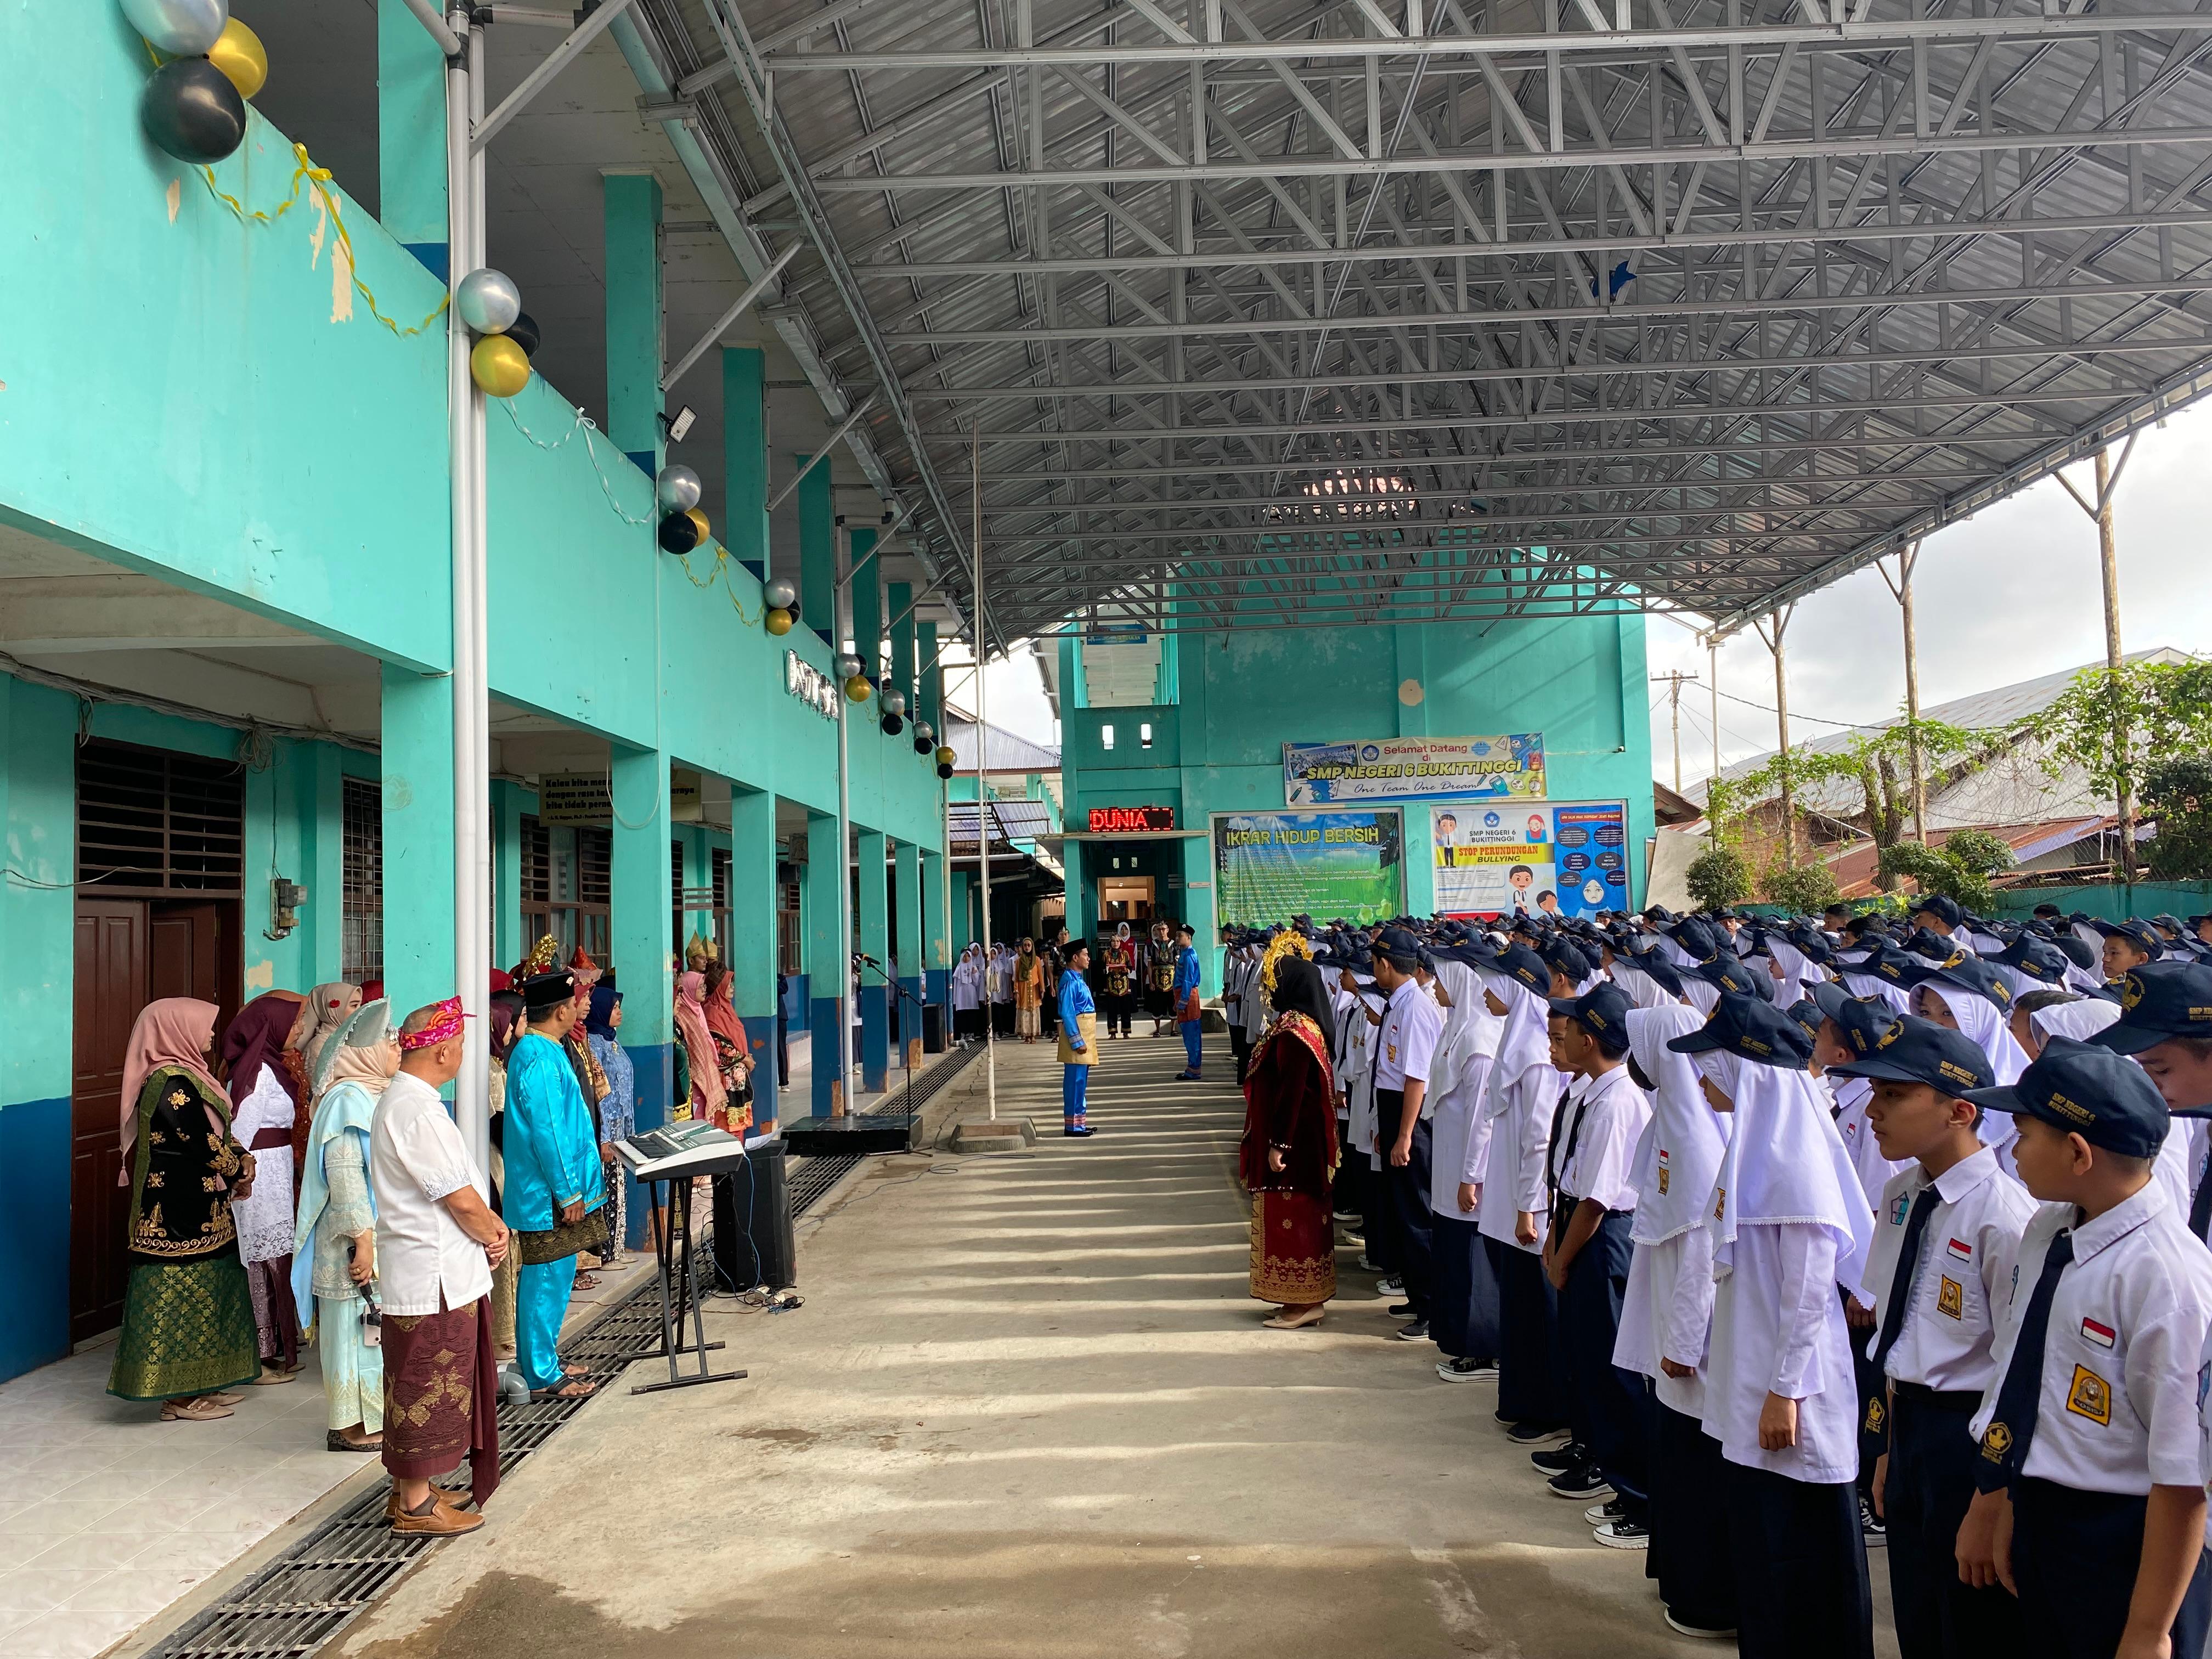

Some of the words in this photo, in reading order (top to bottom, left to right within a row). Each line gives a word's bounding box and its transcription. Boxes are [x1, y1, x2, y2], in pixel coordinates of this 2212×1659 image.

[1384, 745, 1427, 754] Selamat
[1430, 744, 1468, 754] Datang
[1422, 754, 1431, 762] di
[1307, 766, 1341, 780] SMP
[1344, 764, 1402, 778] NEGERI
[1404, 763, 1414, 776] 6
[1417, 759, 1522, 776] BUKITTINGGI
[545, 779, 570, 787] Kalau
[571, 778, 588, 787] kita
[1354, 784, 1376, 794] One
[1381, 782, 1409, 792] Team
[1414, 782, 1435, 791] One
[1441, 781, 1478, 790] Dream
[546, 790, 575, 799] dengan
[672, 788, 695, 796] arnya
[546, 801, 562, 809] kita
[565, 800, 586, 809] tidak
[588, 801, 612, 809] perna
[1092, 811, 1148, 827] DUNIA
[1226, 830, 1271, 846] IKRAR
[1274, 828, 1321, 845] HIDUP
[1324, 827, 1379, 843] BERSIH
[1459, 848, 1477, 856] STOP
[1480, 845, 1538, 856] PERUNDUNGAN
[2052, 1092, 2066, 1104] SMP
[2064, 1099, 2089, 1118] NEGERI
[2048, 1100, 2091, 1127] BUKITTINGGI
